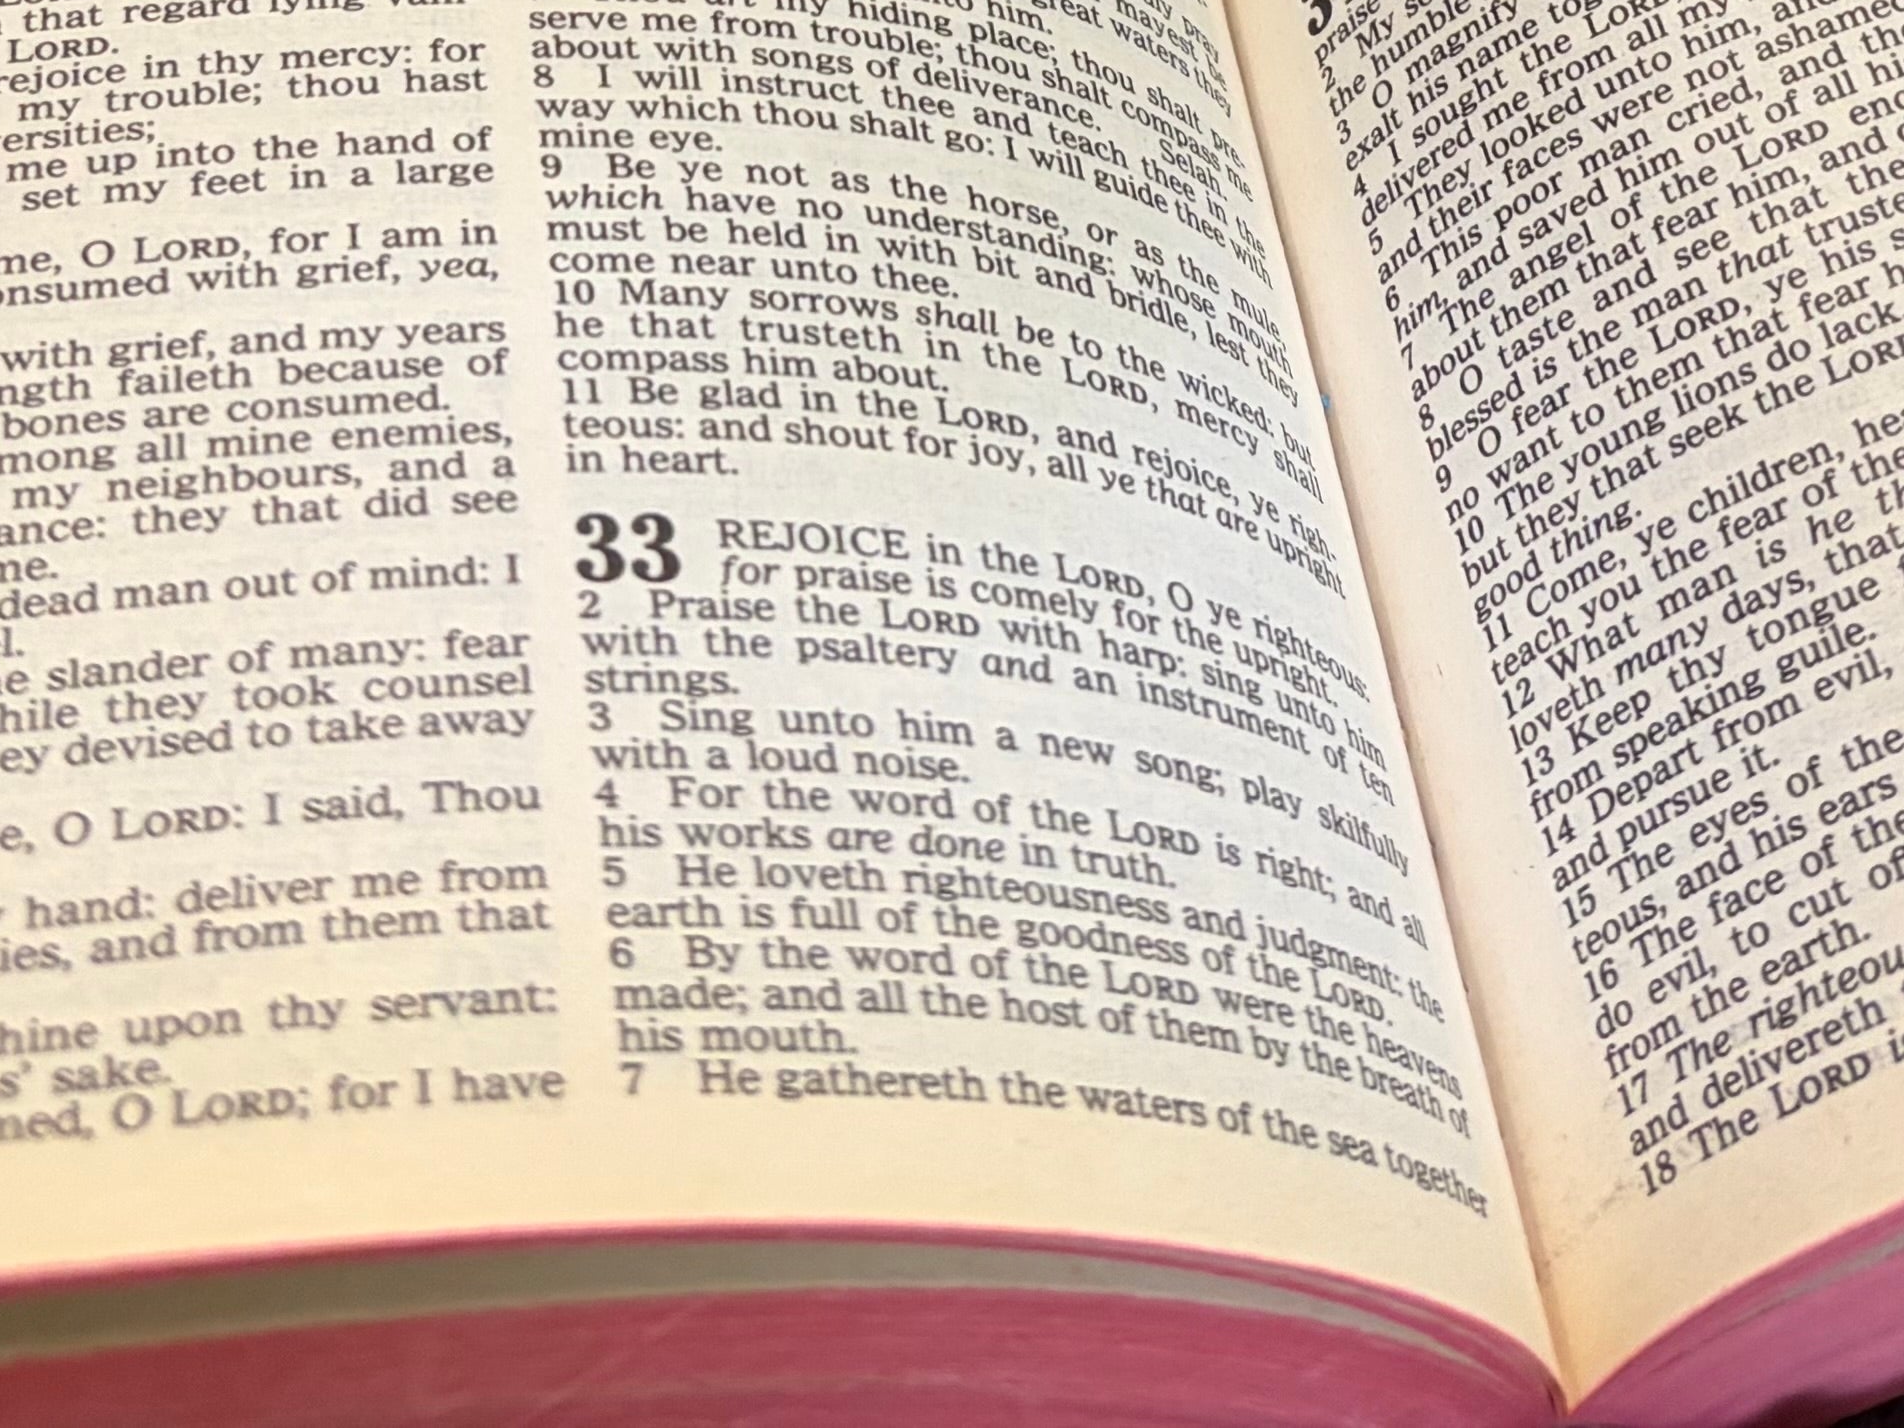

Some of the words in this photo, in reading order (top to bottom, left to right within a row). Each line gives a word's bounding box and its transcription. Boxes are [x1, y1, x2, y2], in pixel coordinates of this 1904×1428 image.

[80, 238, 116, 268] O
[133, 235, 251, 264] LORD,
[268, 226, 330, 254] for
[346, 222, 360, 250] I
[381, 225, 442, 249] am
[460, 217, 498, 246] in
[554, 278, 595, 306] 10
[617, 277, 729, 311] Many
[748, 288, 899, 322] sorrows
[914, 299, 1000, 337] shall
[1014, 314, 1055, 348] be
[1068, 329, 1103, 361] to
[1115, 342, 1166, 382] the
[1176, 369, 1277, 438] wicked:
[1282, 422, 1316, 472] but
[1453, 514, 1485, 557] 10
[1492, 470, 1555, 521] The
[1558, 405, 1667, 485] young
[1669, 360, 1758, 418] lions
[1765, 337, 1812, 372] do
[575, 511, 682, 583] 33
[714, 517, 910, 561] REJOICE
[925, 531, 964, 567] in
[978, 541, 1040, 577] the
[1051, 551, 1156, 607] LORD,
[1166, 580, 1194, 613] O
[1204, 598, 1243, 631] ye
[1251, 613, 1373, 703] righteous:
[52, 809, 93, 847] O
[110, 803, 244, 842] LORD:
[263, 791, 281, 827] I
[300, 783, 405, 824] said,
[419, 779, 542, 815] Thou
[590, 736, 690, 770] with
[705, 745, 732, 771] a
[744, 737, 840, 774] loud
[852, 745, 971, 783] noise.
[618, 1060, 644, 1096] 7
[694, 1057, 762, 1096] He
[774, 1060, 989, 1103] gathereth
[996, 1070, 1067, 1110] the
[1074, 1084, 1209, 1129] waters
[1215, 1100, 1253, 1136] of
[1260, 1107, 1320, 1150] the
[1325, 1129, 1380, 1168] sea
[1638, 1148, 1678, 1197] 18
[1685, 1107, 1760, 1163] The
[1766, 1050, 1873, 1121] LORD
